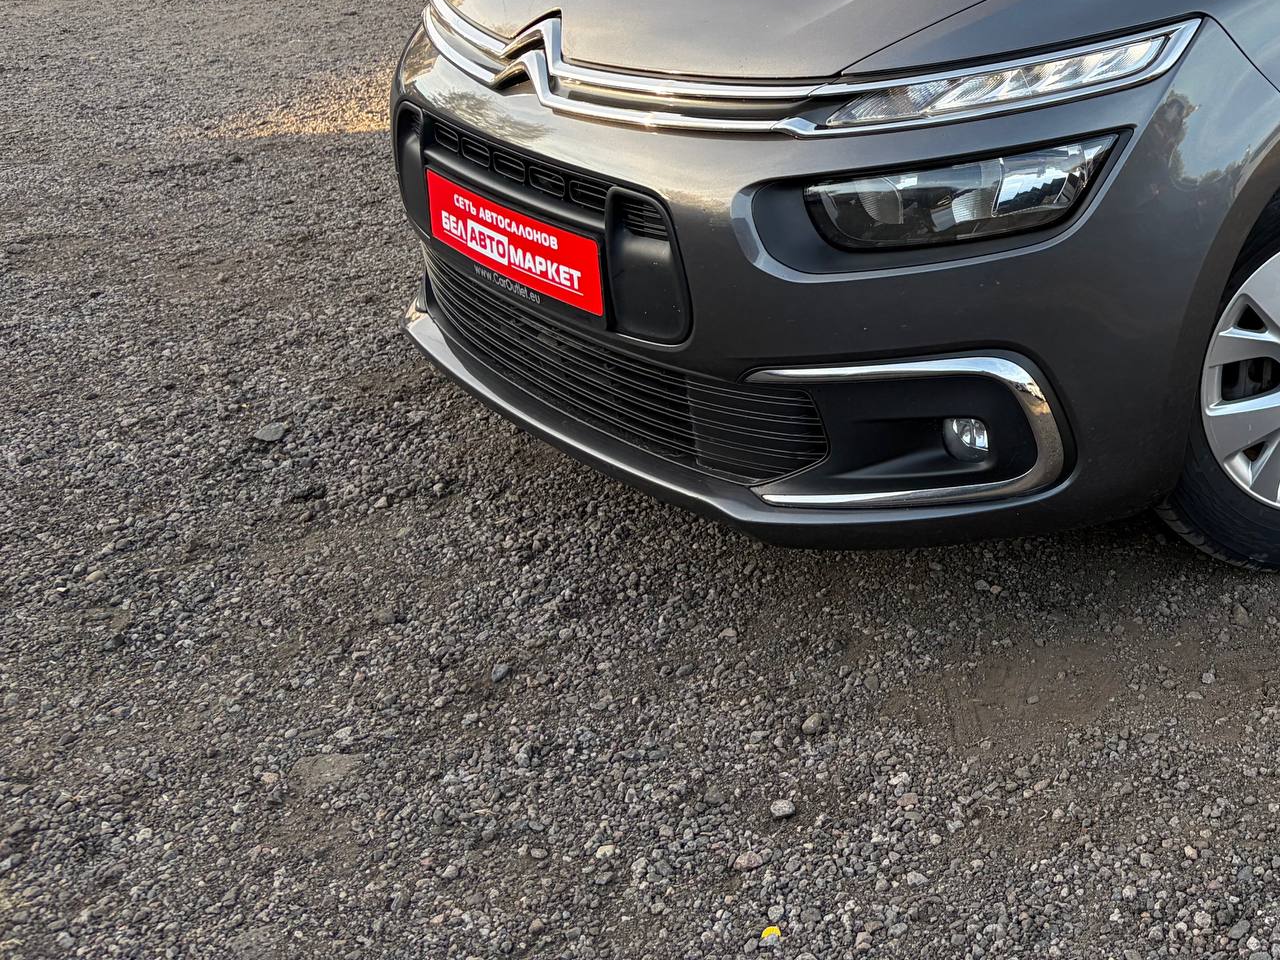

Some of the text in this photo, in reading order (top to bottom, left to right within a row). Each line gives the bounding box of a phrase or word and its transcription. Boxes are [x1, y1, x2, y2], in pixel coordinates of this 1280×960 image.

[441, 210, 582, 290] БЕЛ АВТО МАРКЕТ
[453, 193, 559, 250] СЕТЬ АВТОСАЛОНОВ
[474, 265, 541, 303] www.CarOutlet.eu
